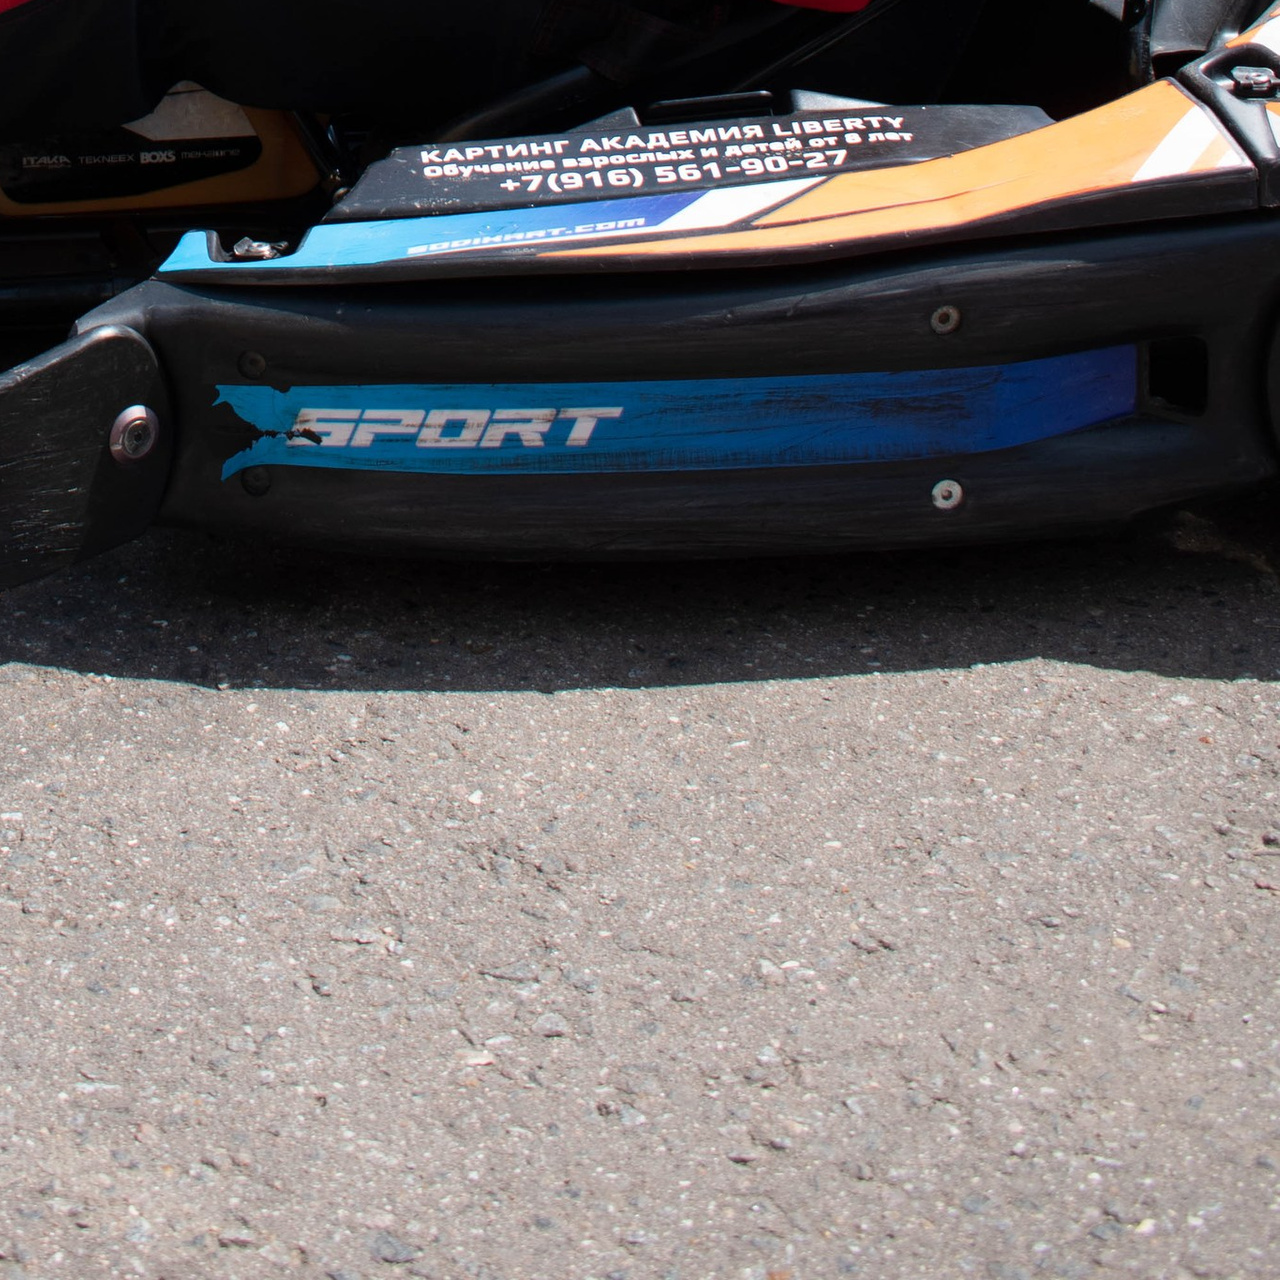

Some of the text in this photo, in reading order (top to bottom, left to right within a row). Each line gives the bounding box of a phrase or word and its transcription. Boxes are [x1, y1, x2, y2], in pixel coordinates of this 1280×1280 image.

[421, 116, 905, 164] КАРТИНГ АКАДЕМИЯ LIBERTY
[423, 157, 556, 178] Обучение
[561, 148, 693, 170] взрослых
[700, 145, 718, 159] и
[724, 135, 803, 157] детей
[809, 135, 839, 147] от
[500, 149, 848, 194] +7(916) 561-90-27
[286, 406, 624, 448] SPORT
